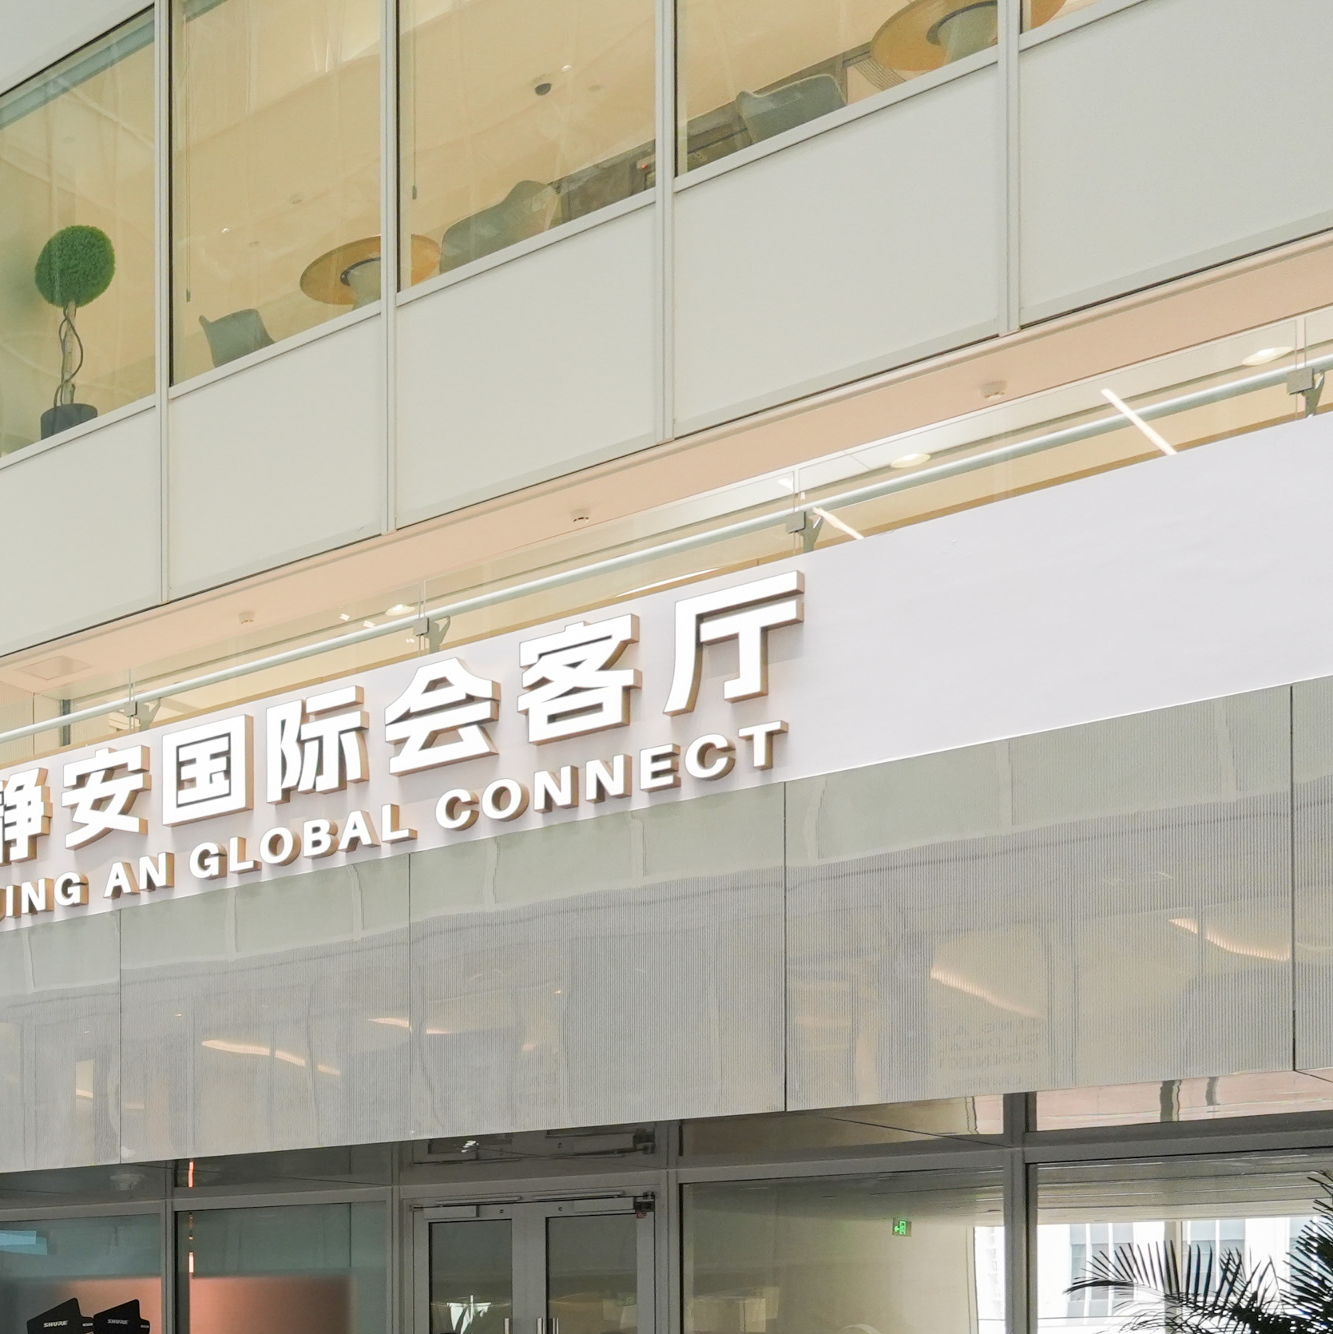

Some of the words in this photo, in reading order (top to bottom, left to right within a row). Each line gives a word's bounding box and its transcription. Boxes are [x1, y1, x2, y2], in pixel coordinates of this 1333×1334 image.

[103, 851, 175, 899] AN
[189, 803, 418, 880] GLOBAL
[434, 720, 789, 831] CONNECT
[43, 1320, 69, 1328] SHURE
